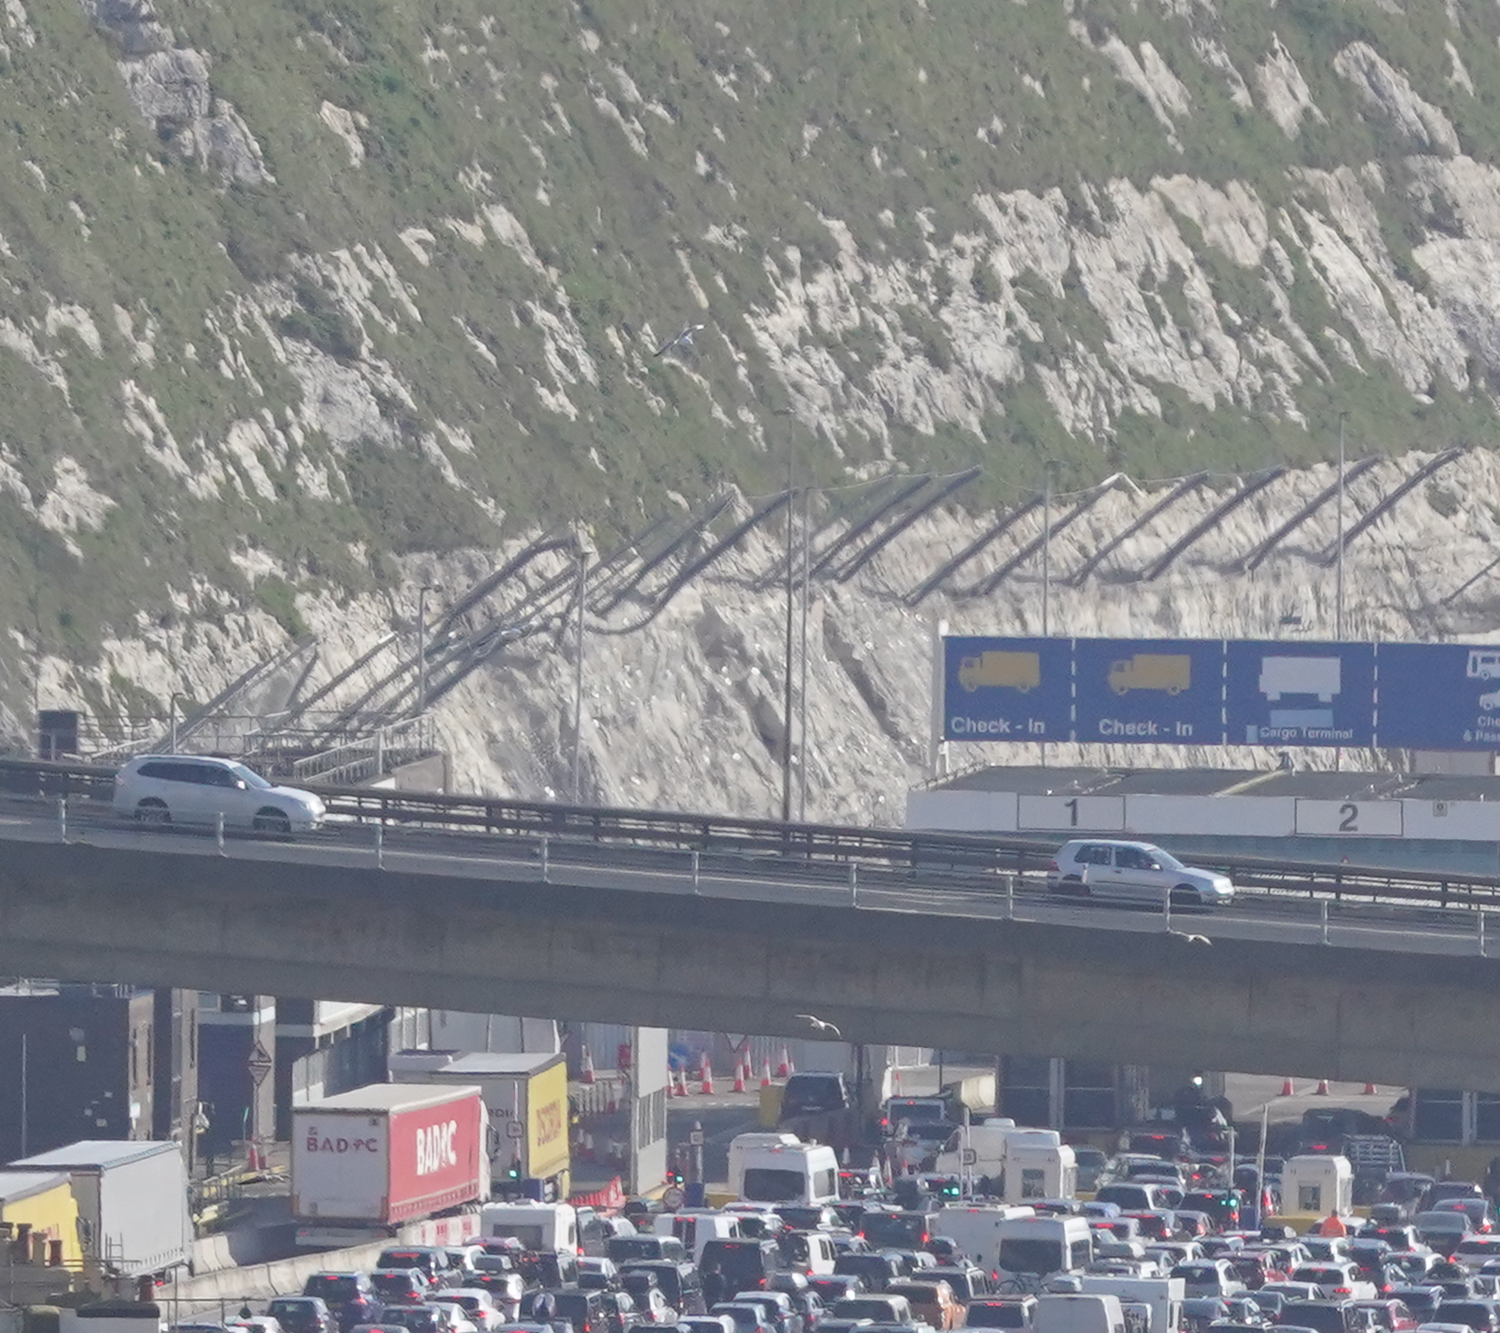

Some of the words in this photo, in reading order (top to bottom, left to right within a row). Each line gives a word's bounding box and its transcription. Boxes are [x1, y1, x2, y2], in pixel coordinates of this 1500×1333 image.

[951, 715, 1006, 735] Check
[1099, 717, 1154, 737] Check
[1066, 800, 1079, 828] 1
[1338, 803, 1359, 831] 2
